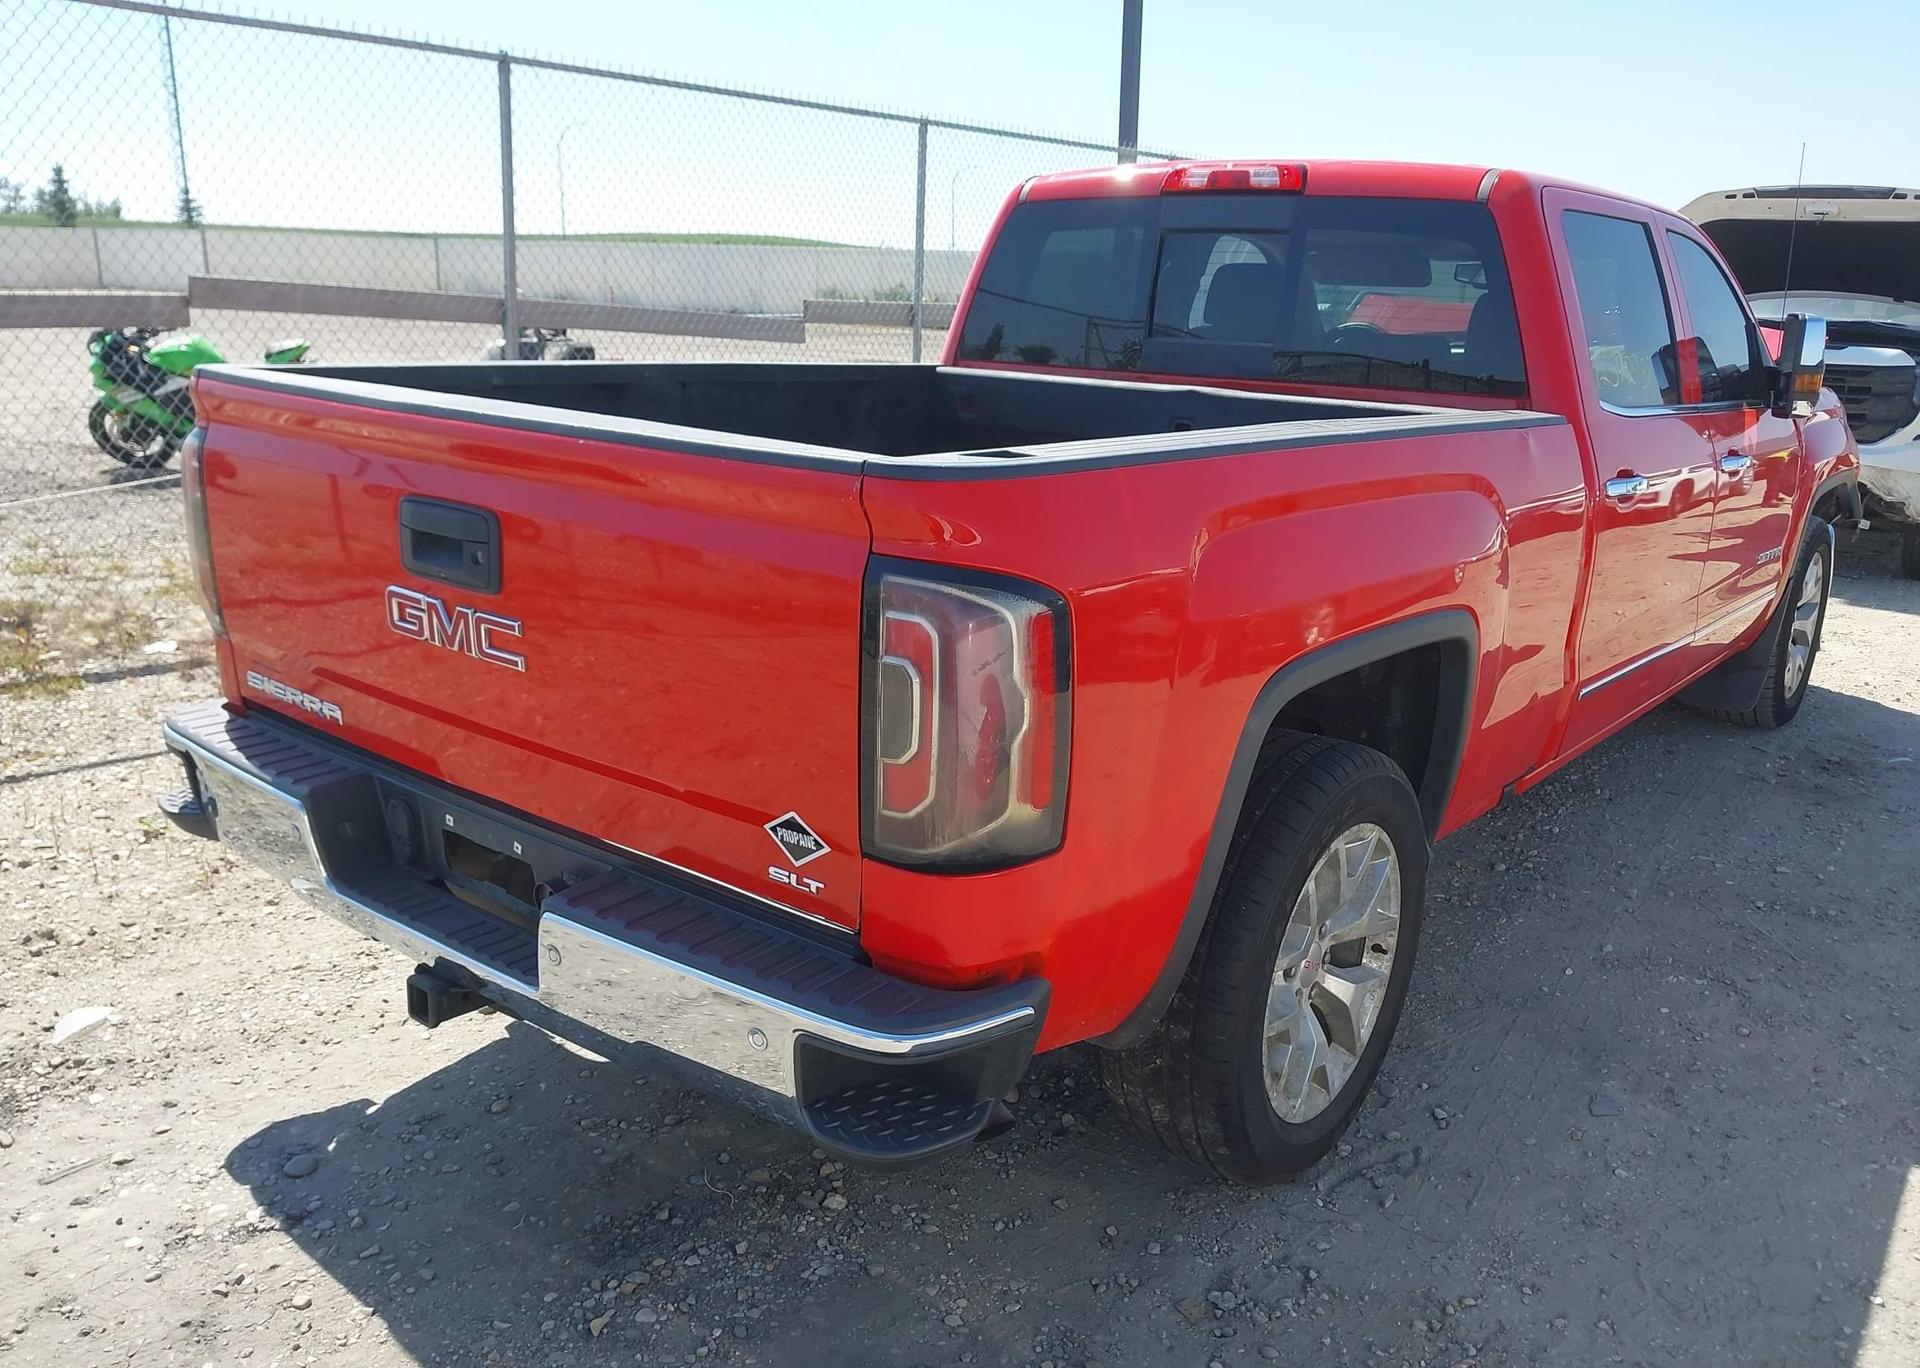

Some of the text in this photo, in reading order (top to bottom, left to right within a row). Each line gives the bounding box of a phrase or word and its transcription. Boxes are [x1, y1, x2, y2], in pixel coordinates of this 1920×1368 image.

[385, 584, 526, 672] GMC
[246, 670, 344, 726] SIERRA
[776, 826, 817, 851] PROPANE
[768, 865, 825, 895] SLT
